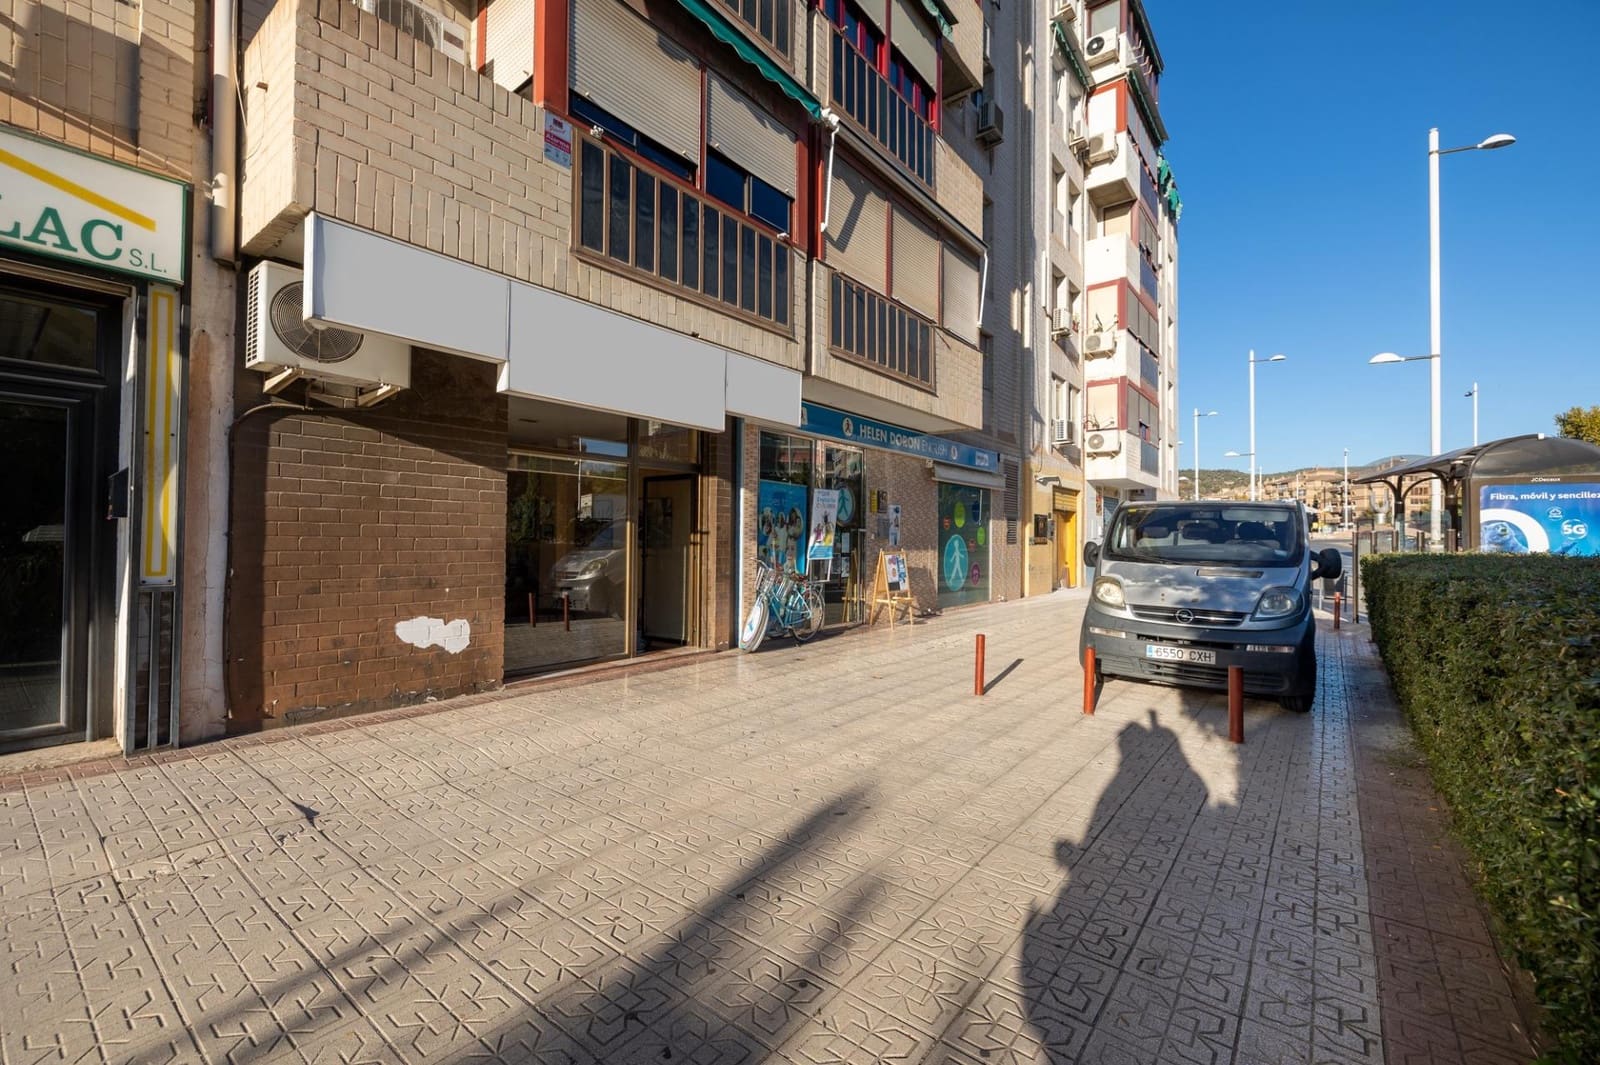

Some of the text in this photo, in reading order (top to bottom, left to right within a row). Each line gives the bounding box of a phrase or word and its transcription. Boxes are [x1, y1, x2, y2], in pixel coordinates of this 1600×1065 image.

[129, 248, 167, 273] S.L.
[859, 424, 888, 442] HELEN
[890, 431, 921, 450] DORON
[1520, 491, 1548, 500] móvil
[1549, 493, 1556, 501] y
[1563, 524, 1586, 534] 5G
[1156, 647, 1212, 662] 6550 CXH
